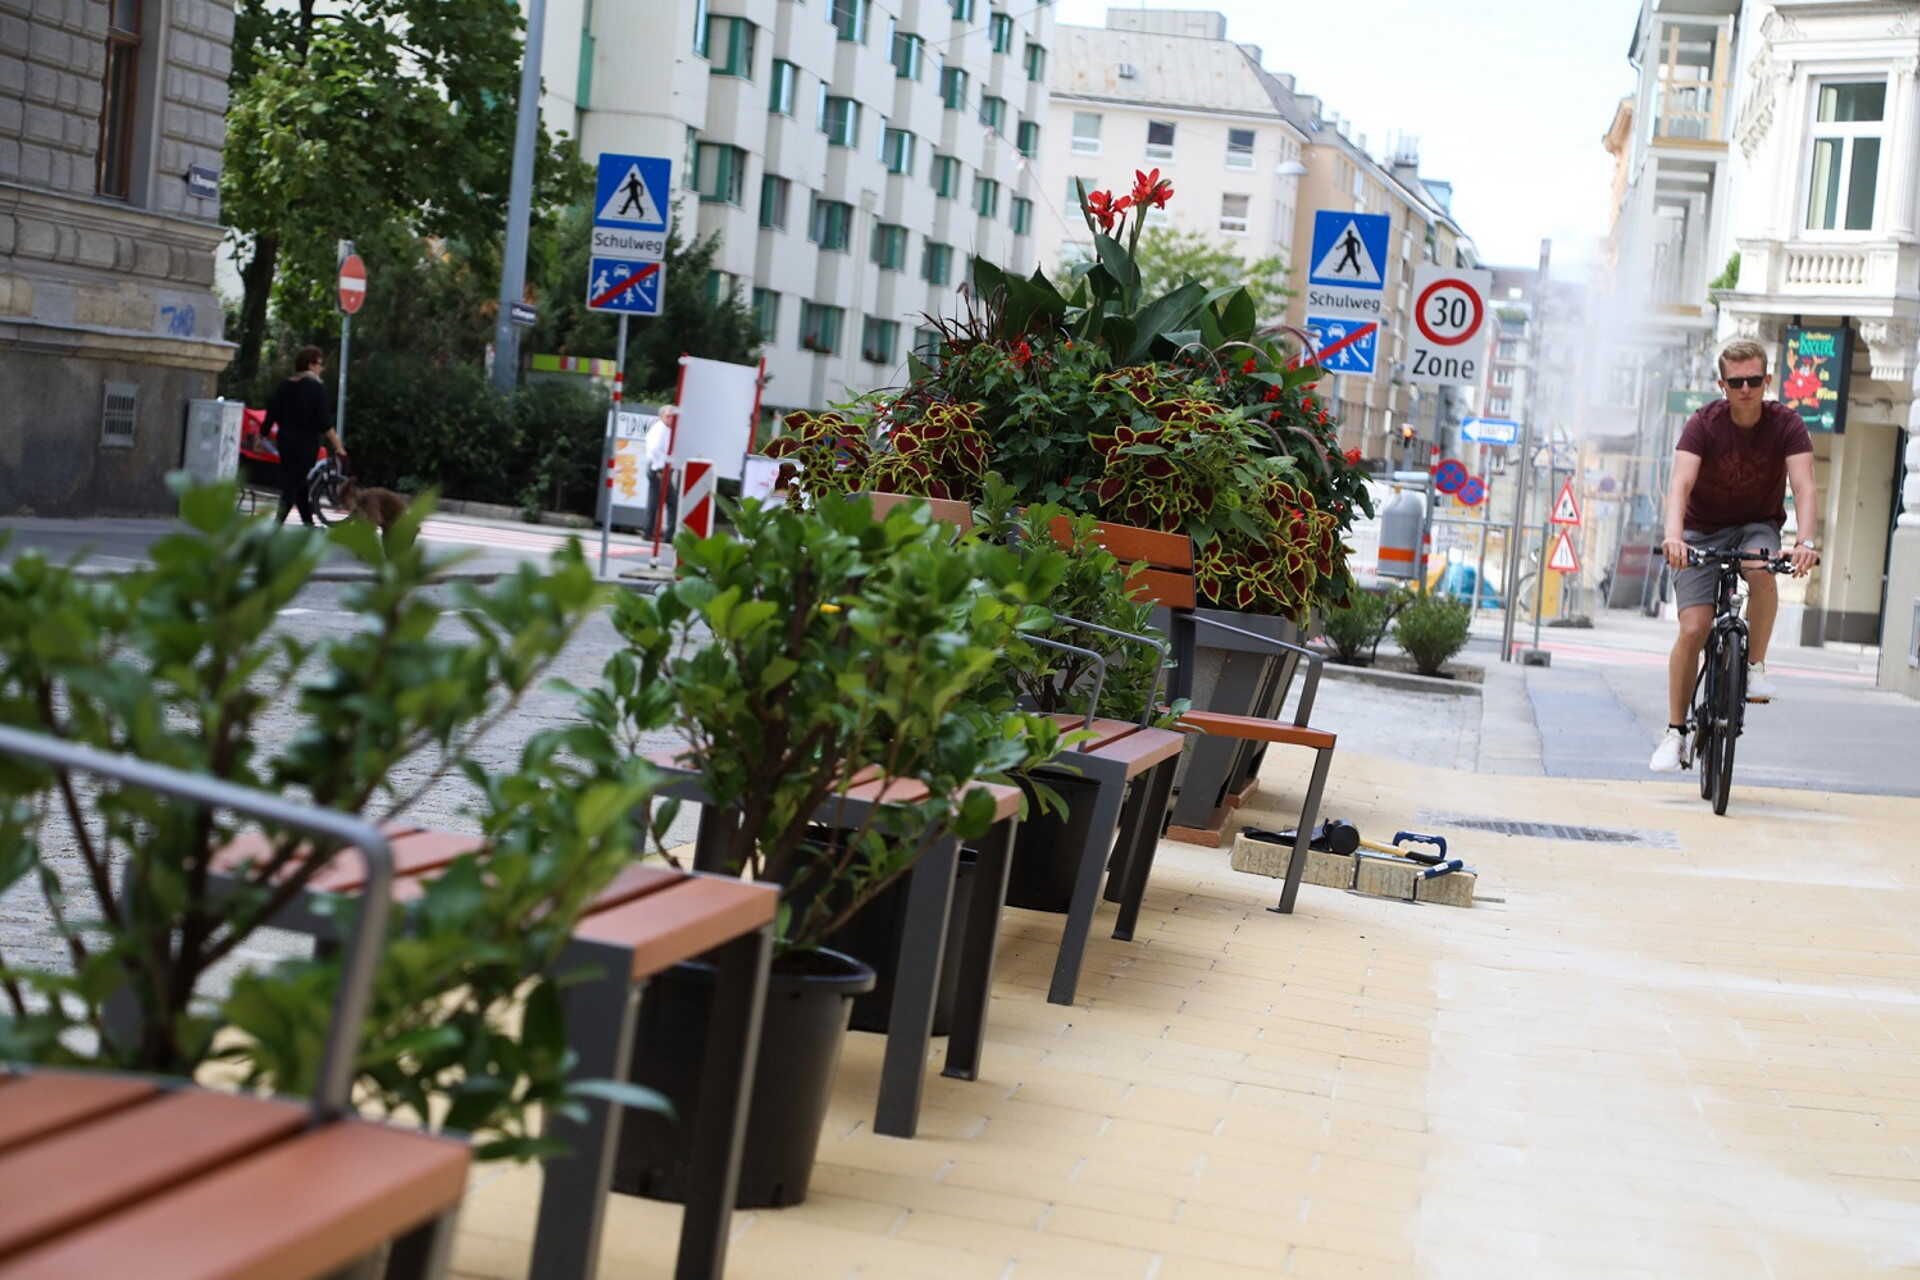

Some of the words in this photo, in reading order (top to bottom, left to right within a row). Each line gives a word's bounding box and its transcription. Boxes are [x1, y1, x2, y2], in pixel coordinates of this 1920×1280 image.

[595, 232, 663, 254] Schulweg
[1309, 291, 1381, 313] Schulweg
[1432, 297, 1466, 328] 30
[1412, 348, 1475, 380] Zone
